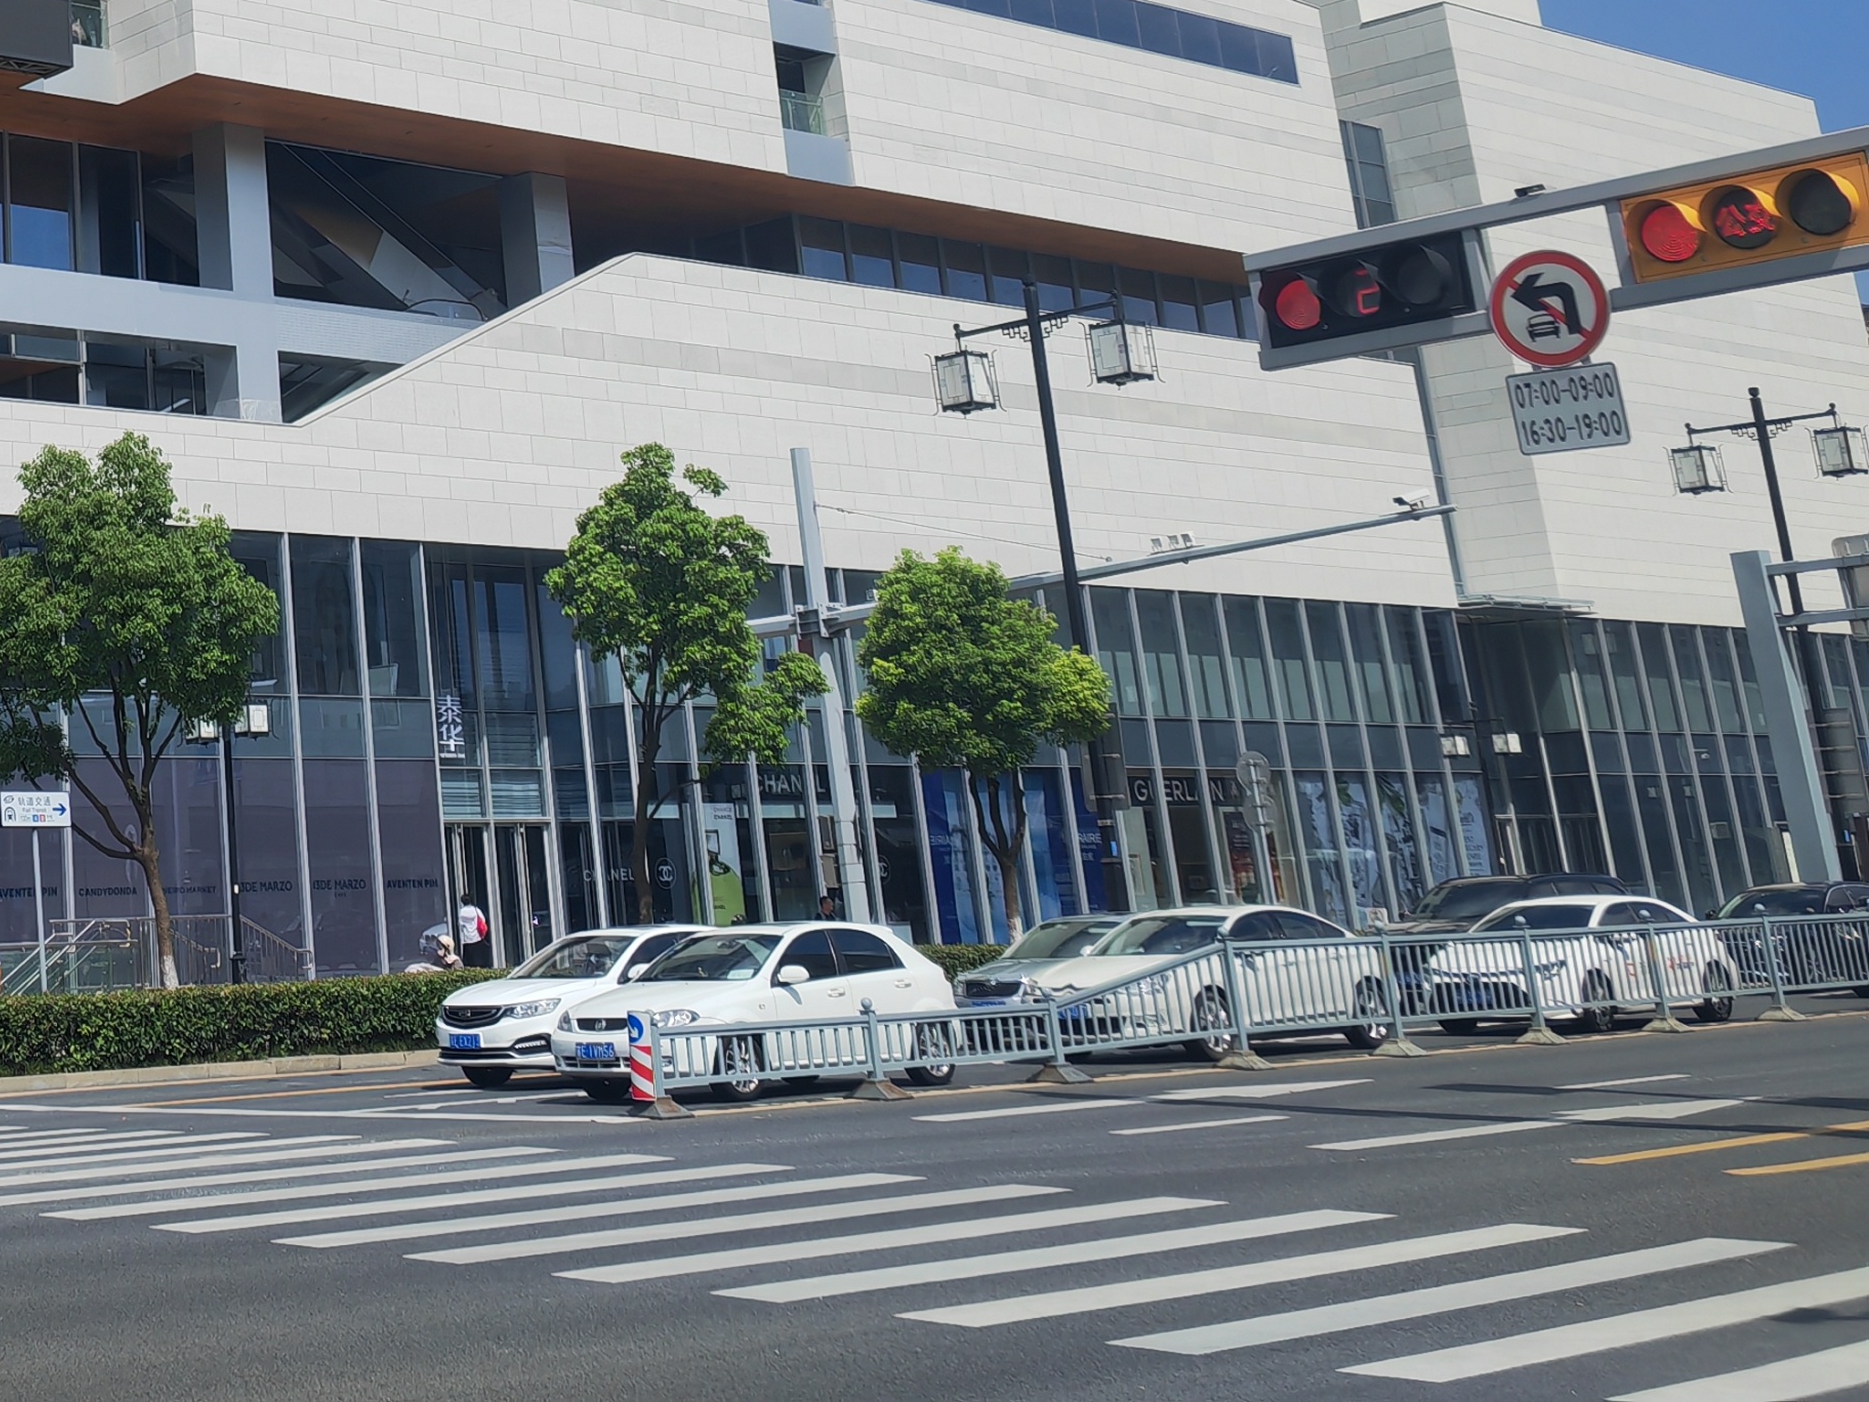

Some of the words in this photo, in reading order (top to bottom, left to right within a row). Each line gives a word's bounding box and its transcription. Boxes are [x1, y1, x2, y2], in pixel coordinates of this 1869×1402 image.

[1514, 372, 1615, 409] 07:00-09:00
[1521, 410, 1623, 446] 16:30-19:00
[437, 694, 465, 751] 泰华
[758, 774, 826, 793] HANL
[1134, 779, 1226, 802] GERLN
[259, 880, 293, 892] MARZO
[583, 868, 635, 882] CNEL
